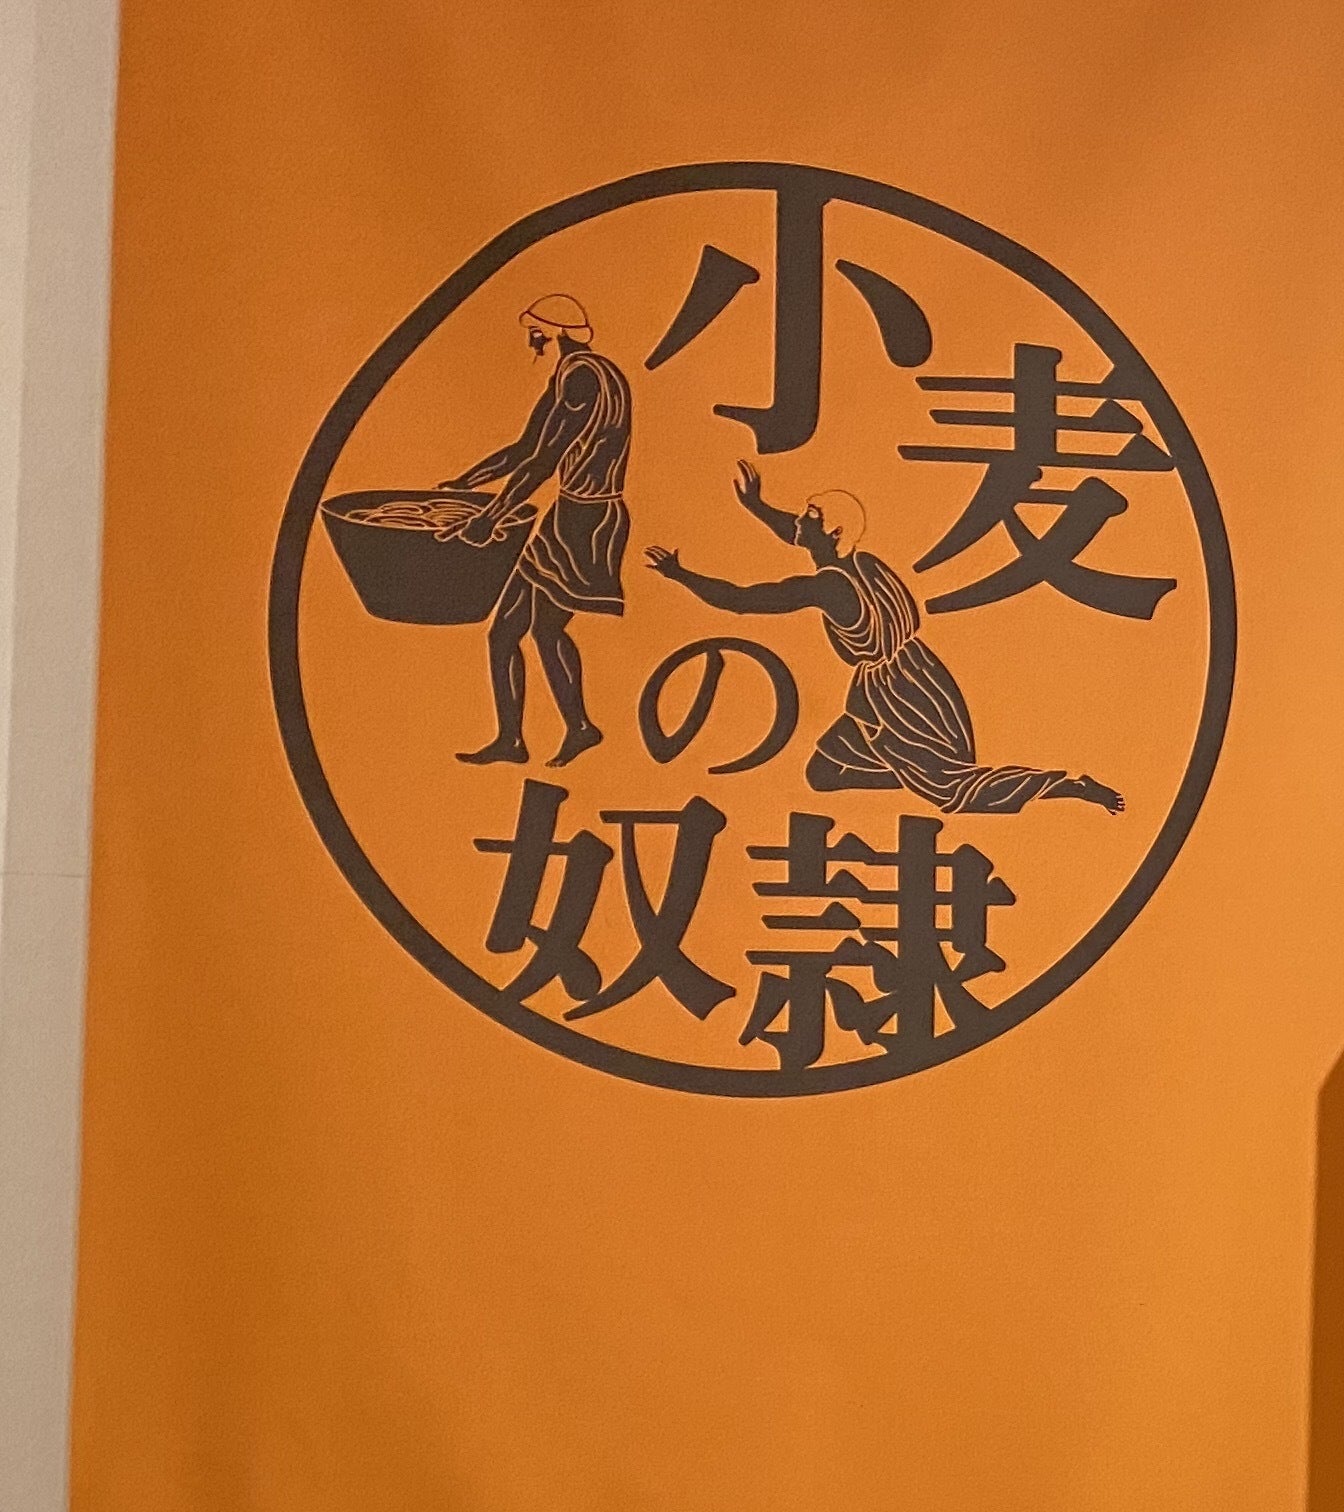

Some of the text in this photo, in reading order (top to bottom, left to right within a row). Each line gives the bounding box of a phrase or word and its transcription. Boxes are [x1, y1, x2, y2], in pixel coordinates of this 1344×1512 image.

[645, 188, 1177, 620] 小麦
[638, 636, 799, 775] の
[473, 777, 1015, 1071] 奴隷
